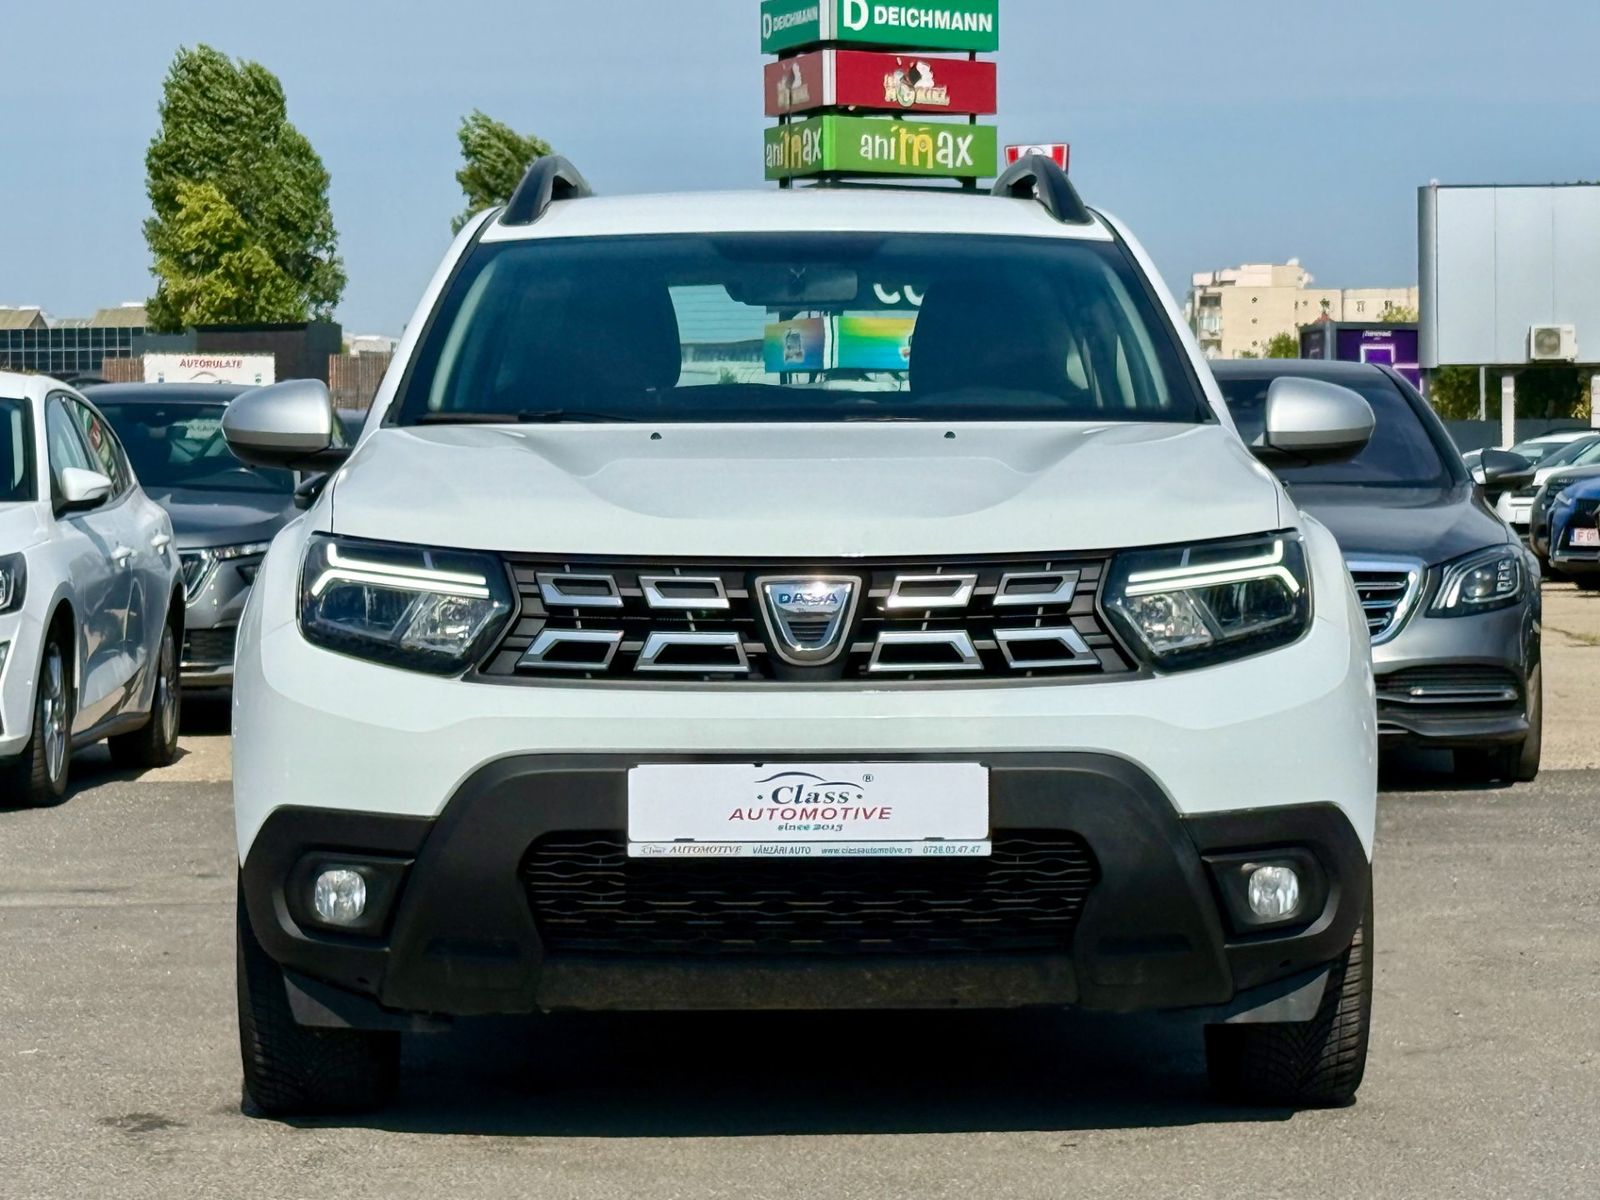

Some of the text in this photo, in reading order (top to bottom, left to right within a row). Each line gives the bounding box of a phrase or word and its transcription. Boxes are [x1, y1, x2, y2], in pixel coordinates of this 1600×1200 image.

[843, 0, 993, 33] D DEICHMANN
[766, 127, 822, 169] animax
[860, 127, 974, 169] animax
[179, 358, 243, 369] AUTORULATE
[771, 784, 850, 805] Class
[728, 807, 892, 821] AUTOMOTIVE
[777, 822, 810, 831] since
[669, 846, 742, 854] AUTOMOTIVE
[790, 846, 811, 854] AUTO
